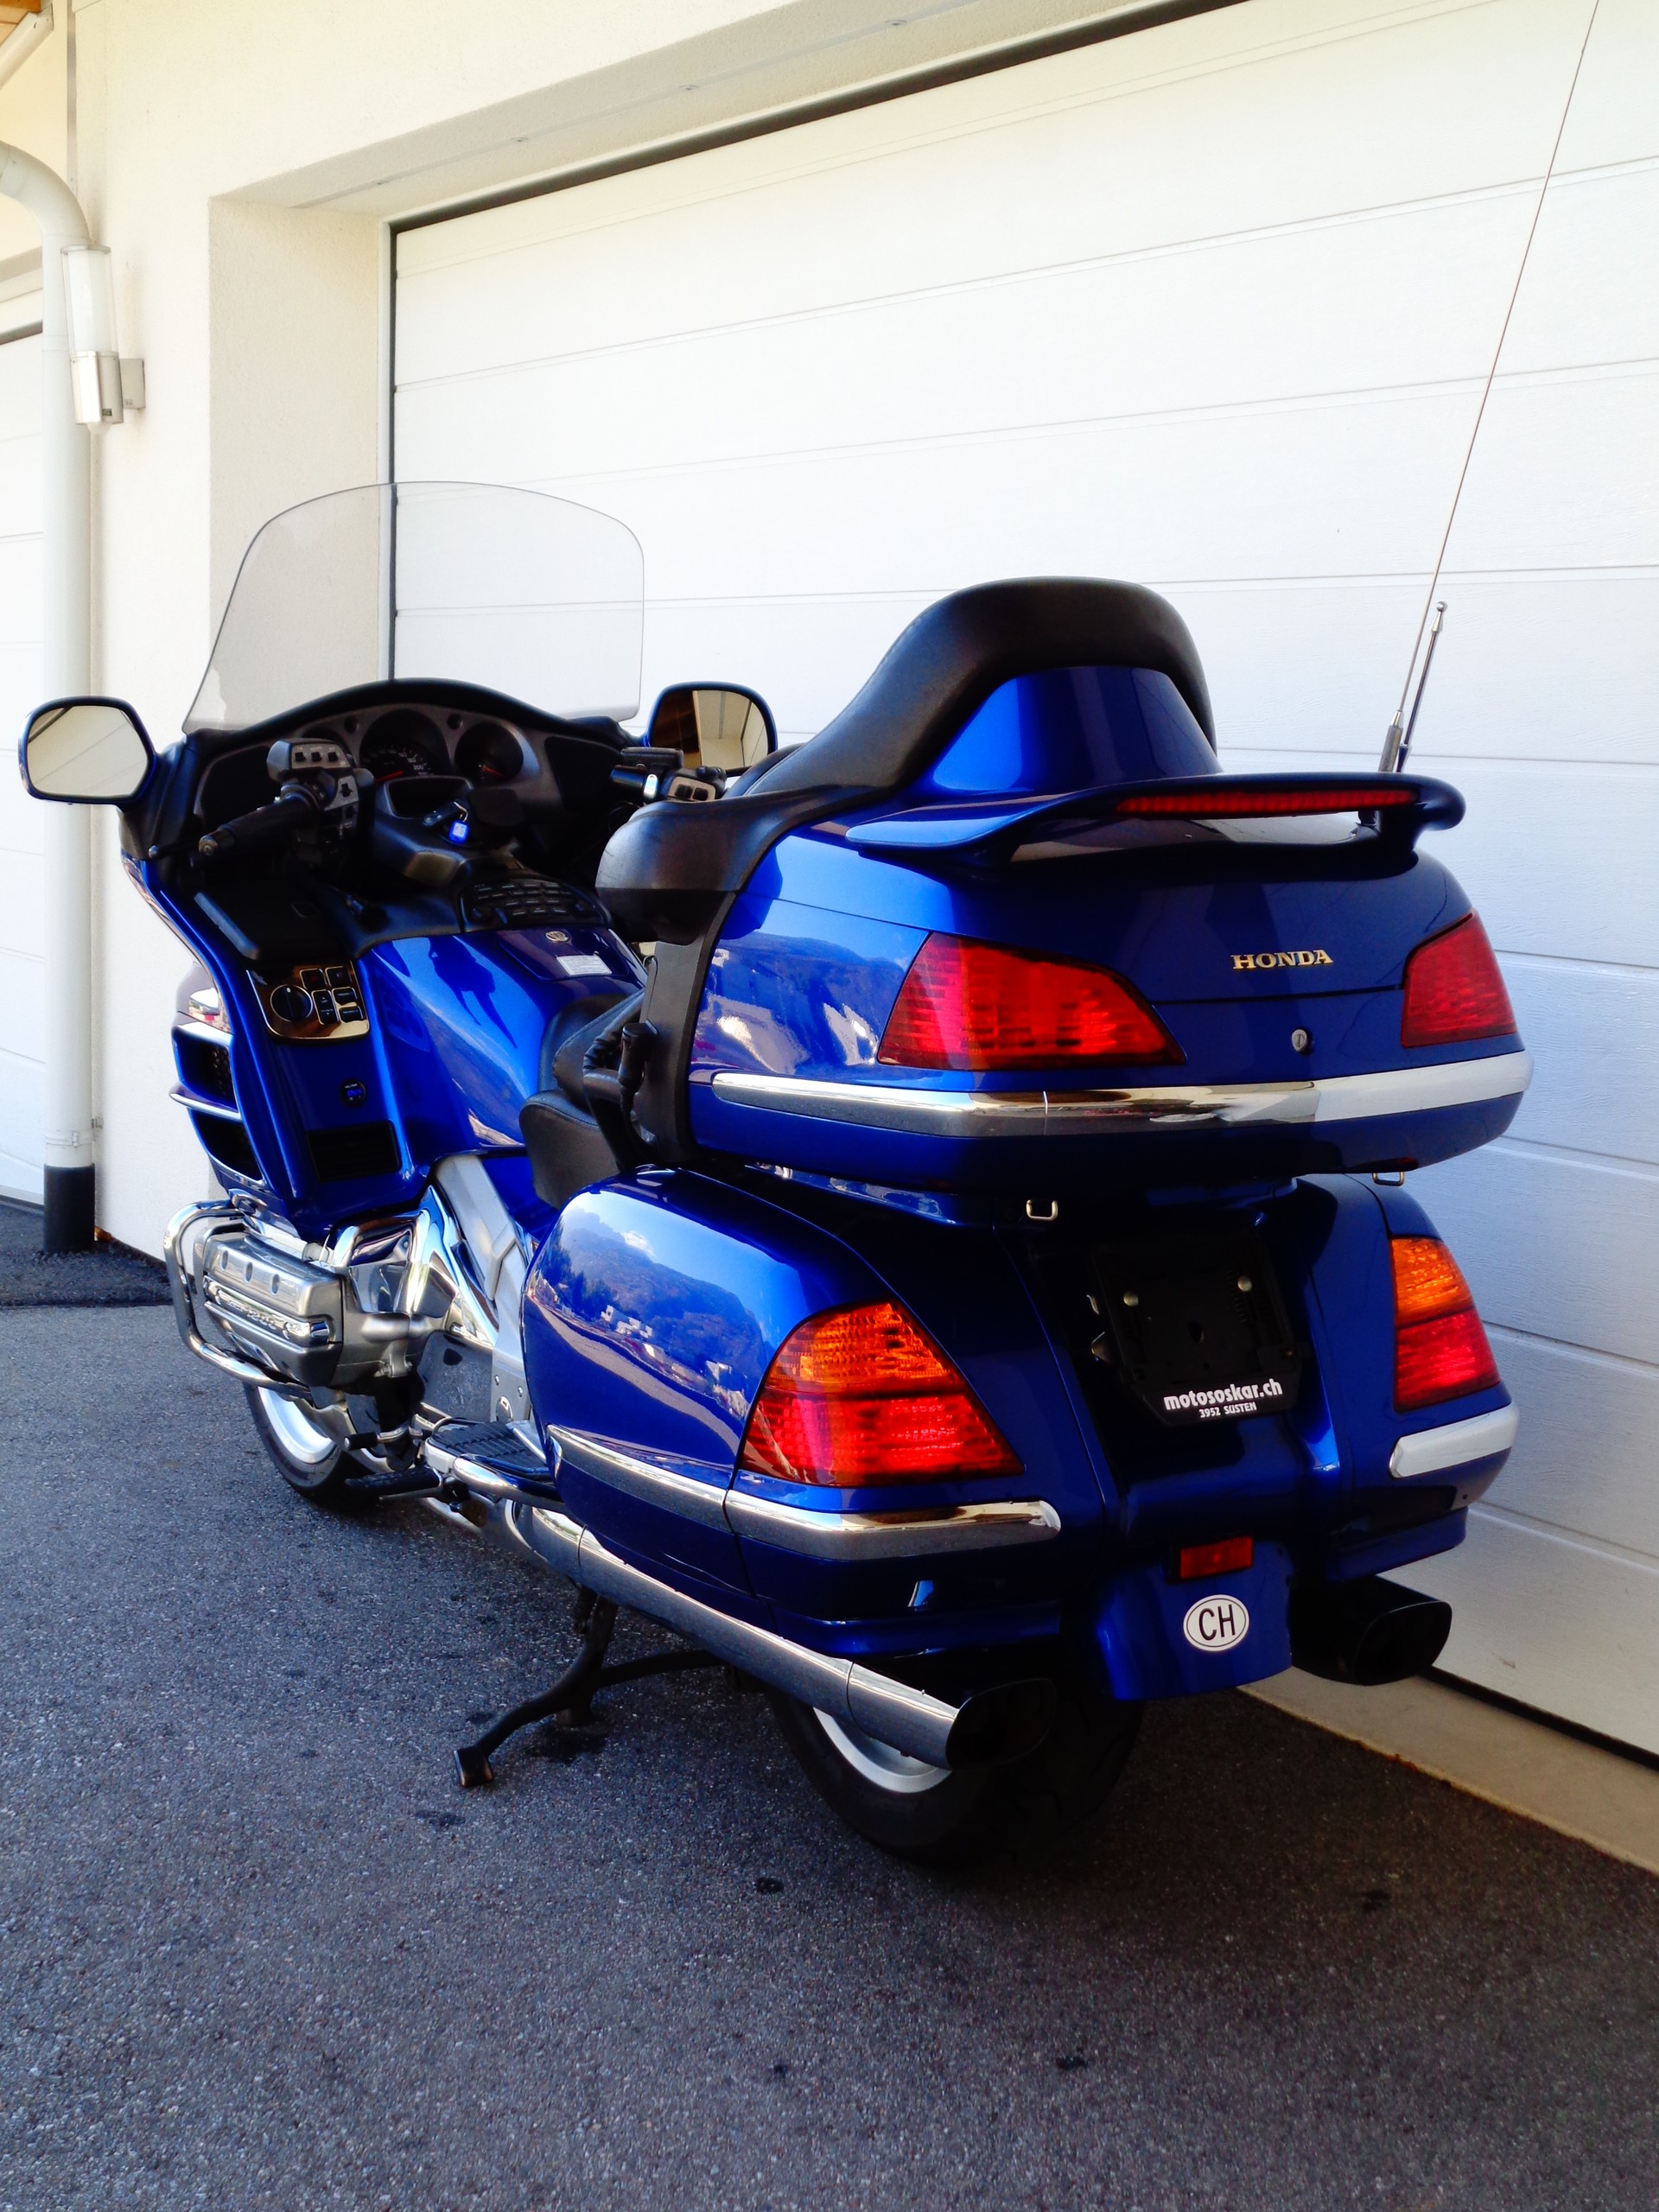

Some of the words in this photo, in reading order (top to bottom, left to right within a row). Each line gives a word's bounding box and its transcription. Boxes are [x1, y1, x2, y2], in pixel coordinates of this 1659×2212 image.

[1230, 950, 1333, 969] HONDA
[1163, 1378, 1283, 1410] motososkar.ch
[1198, 1407, 1221, 1418] 3952
[1224, 1402, 1257, 1414] SUSTEN
[1198, 1604, 1236, 1641] CH
